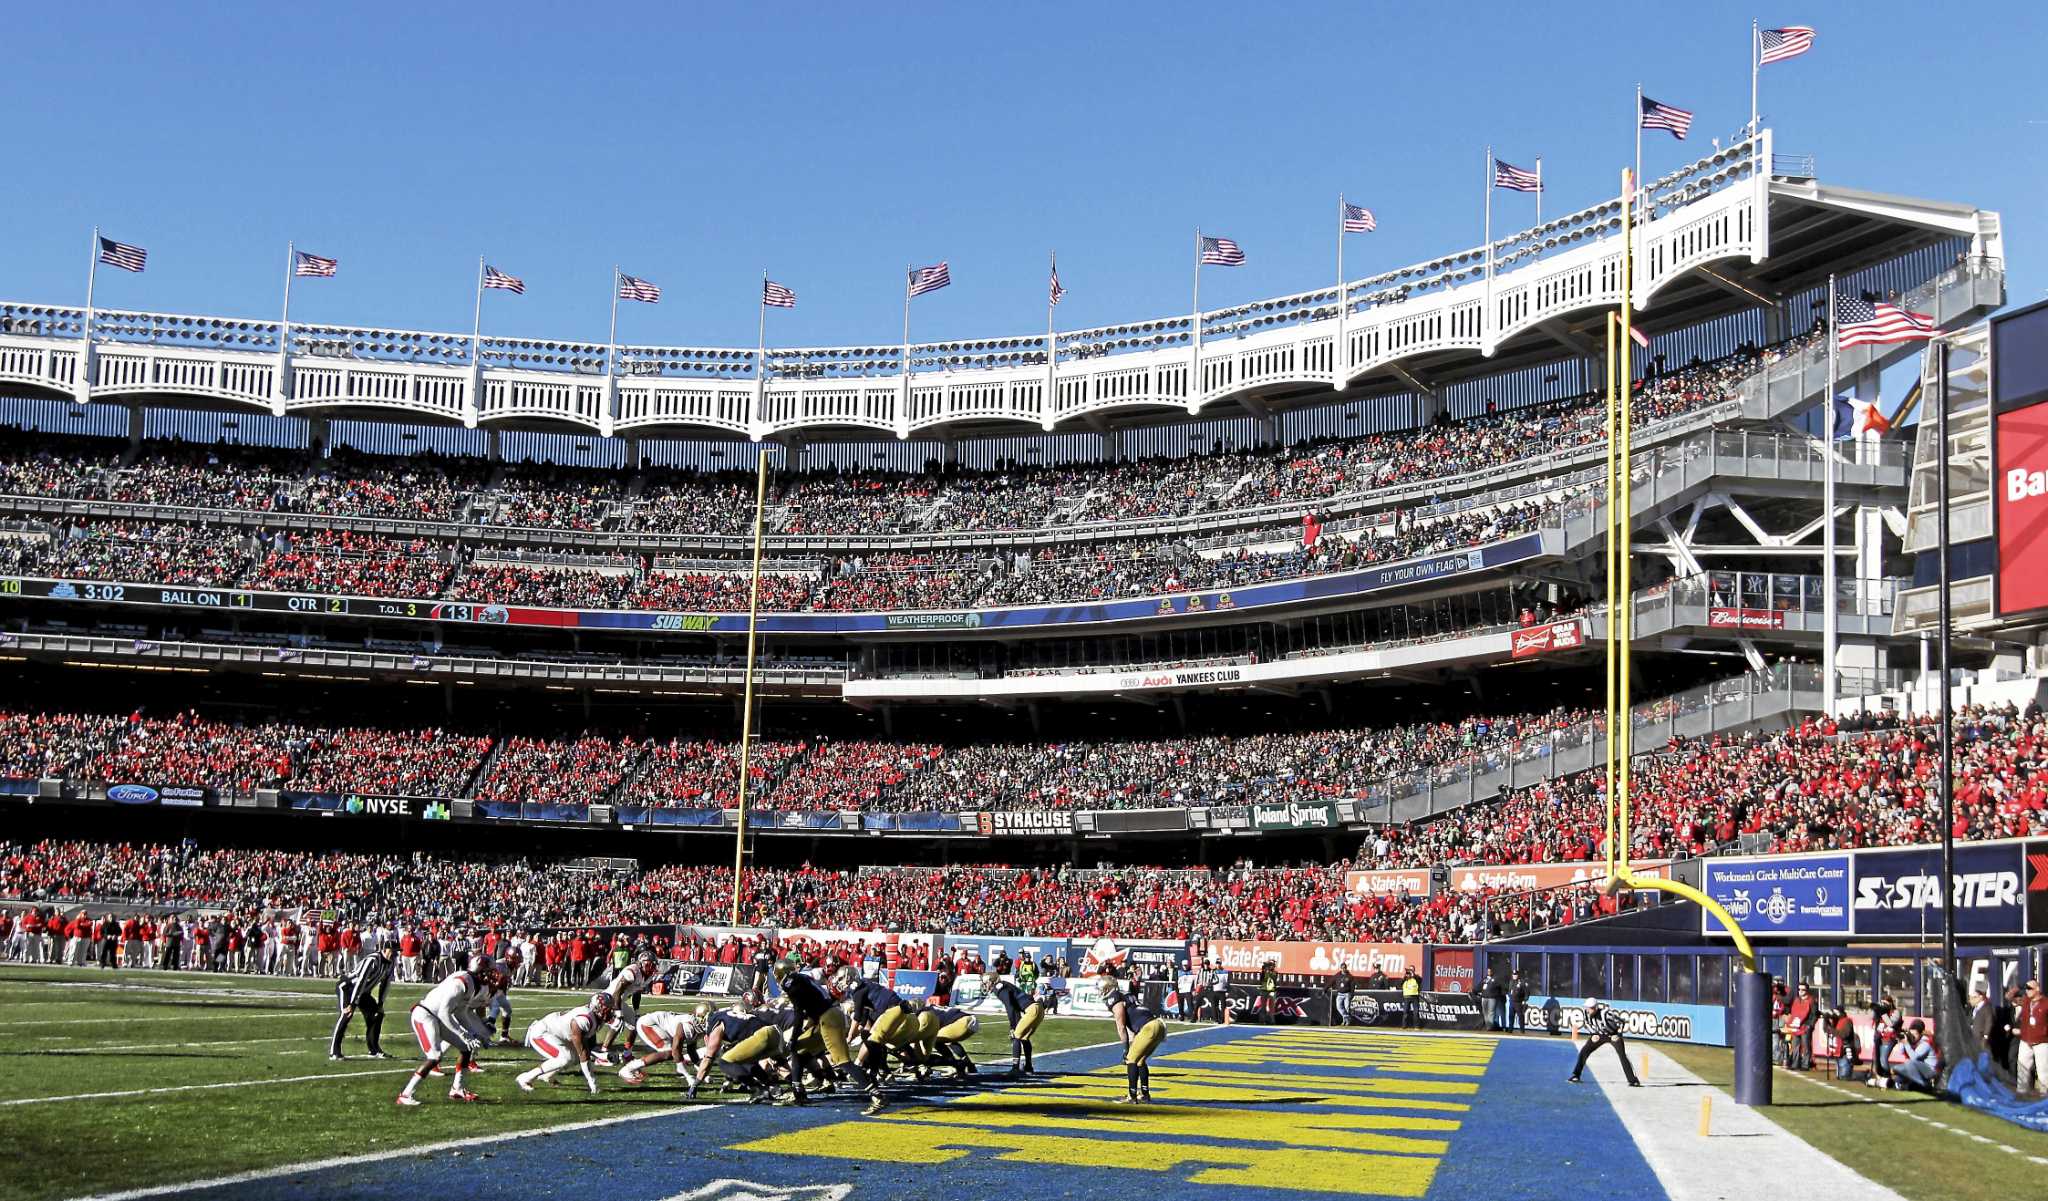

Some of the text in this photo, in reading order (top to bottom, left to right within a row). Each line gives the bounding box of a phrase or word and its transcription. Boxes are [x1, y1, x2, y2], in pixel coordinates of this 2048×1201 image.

[2008, 468, 2048, 501] Ba
[1380, 572, 1394, 584] FLY
[1395, 567, 1415, 581] YOUR
[1416, 563, 1435, 577] OWN
[1436, 559, 1455, 573] FLAG
[1, 579, 19, 593] 10
[85, 585, 124, 601] 3:02
[162, 591, 221, 606] BALL ON
[237, 594, 245, 606] 1
[288, 597, 318, 610] QTR
[331, 599, 341, 613] 2
[407, 603, 417, 616] 3
[448, 605, 468, 621] 13
[651, 615, 719, 630] SUBWAY
[1710, 611, 1782, 627] Budweiser
[1142, 669, 1241, 687] Audi YANKEES CLUB
[117, 786, 149, 801] Ford
[994, 812, 1072, 828] SYRACUSE
[1253, 803, 1329, 828] Poland Spring
[1713, 866, 1844, 883] Workmen's Circle MultiCare Center
[1430, 1004, 1480, 1015] FOOTBALL
[1436, 1013, 1458, 1021] HERE
